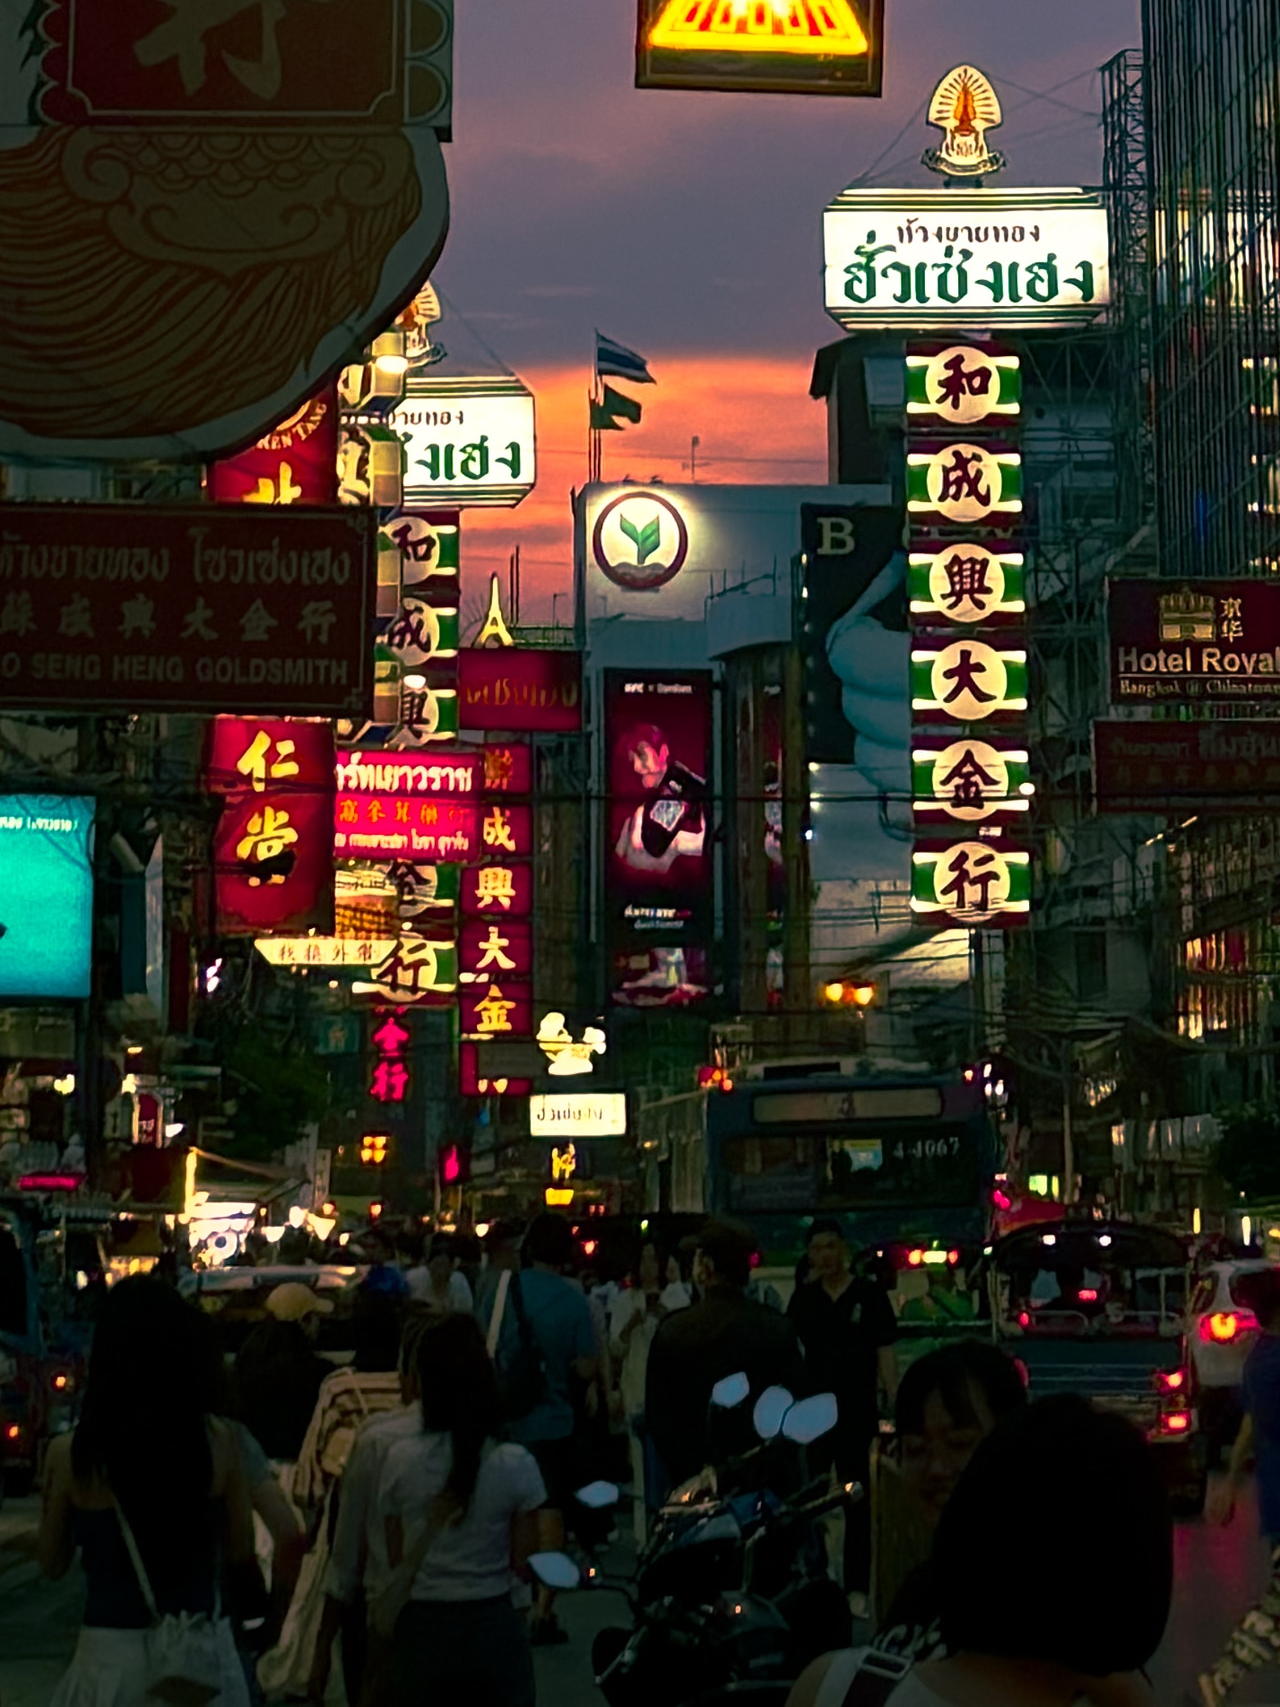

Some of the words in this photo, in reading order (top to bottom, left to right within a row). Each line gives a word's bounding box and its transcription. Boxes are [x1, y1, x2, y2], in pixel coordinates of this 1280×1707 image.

[896, 217, 1041, 245] ห้างขายทอง
[843, 229, 1095, 304] ฮั่วเซ่งเฮง
[937, 353, 1002, 911] 和成興大金行
[111, 654, 185, 683] HENG
[195, 656, 349, 686] GOLDSMITH
[1118, 646, 1192, 673] Hotel
